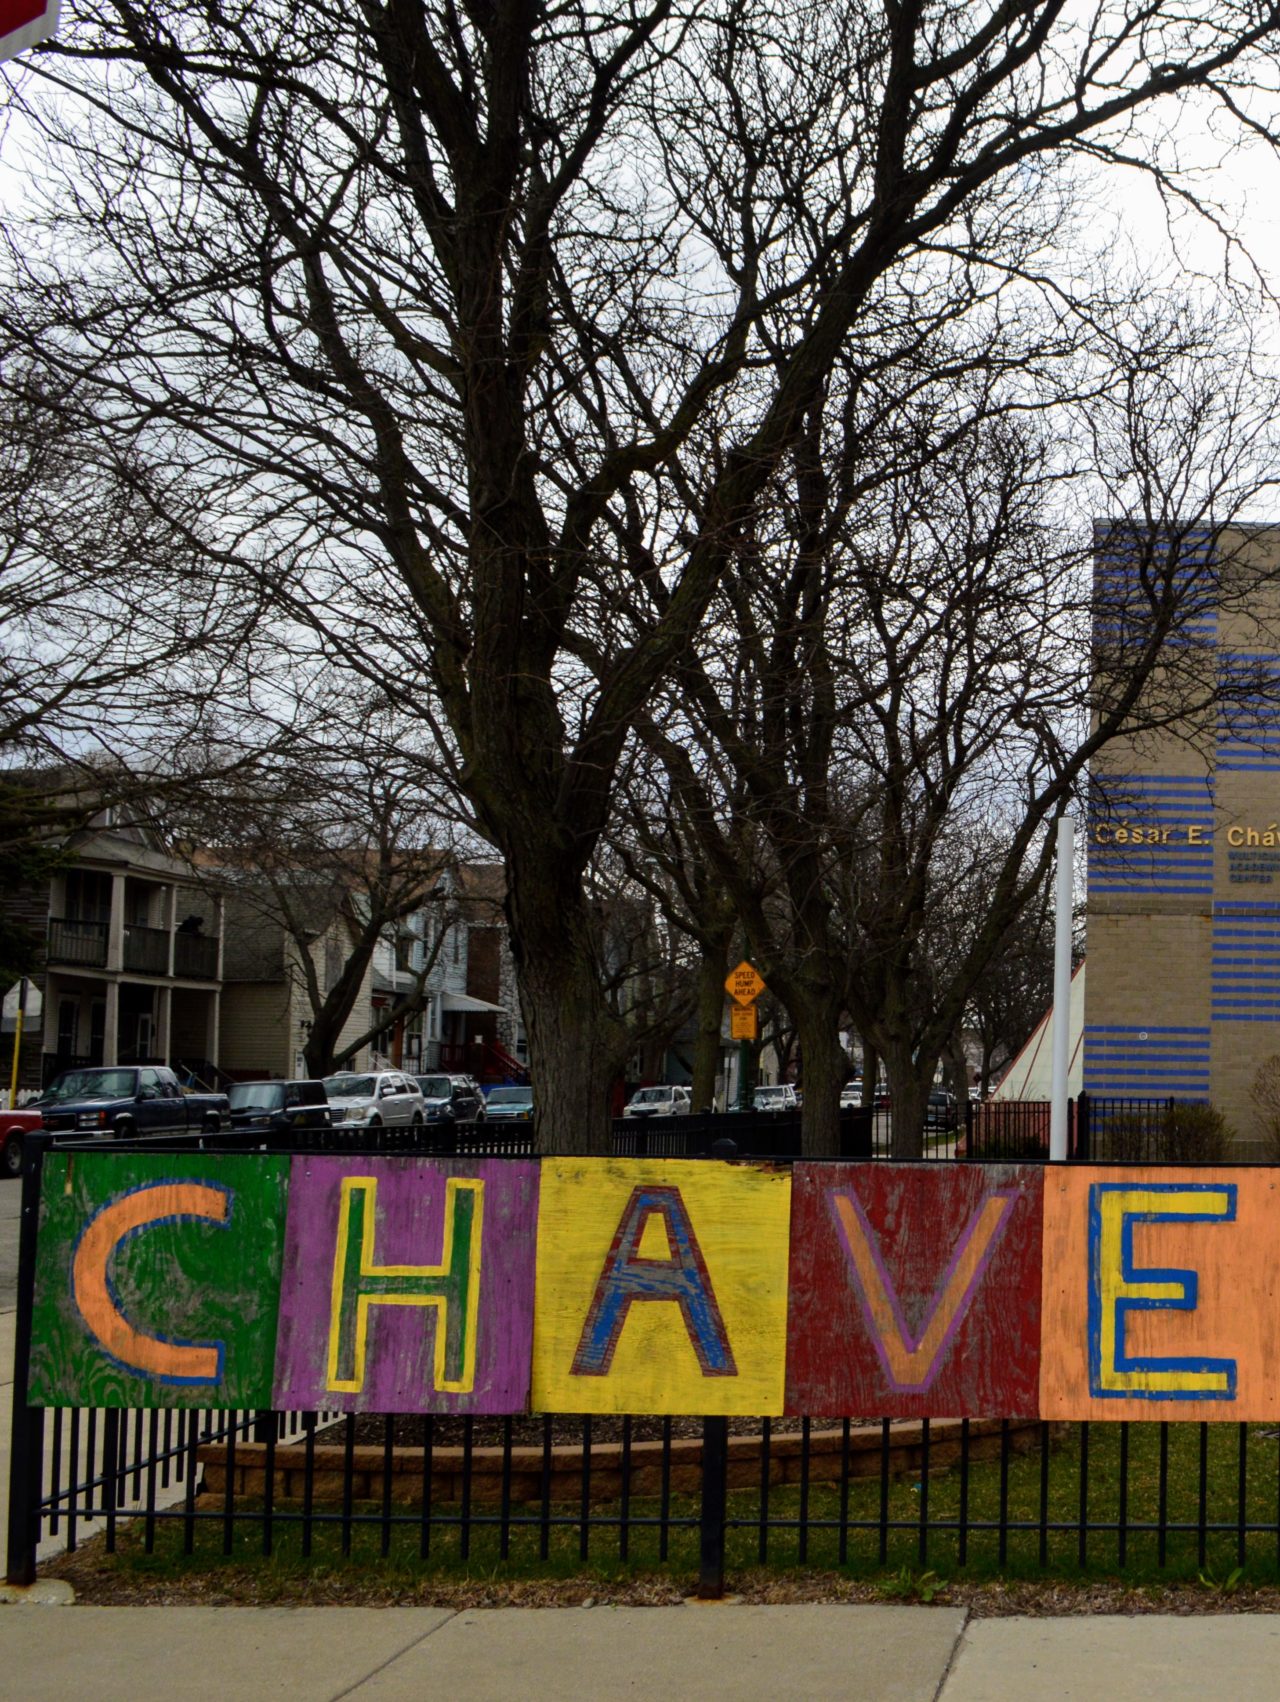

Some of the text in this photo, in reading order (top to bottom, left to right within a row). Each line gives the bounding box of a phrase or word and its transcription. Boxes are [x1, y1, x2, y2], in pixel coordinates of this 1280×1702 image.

[1095, 820, 1171, 844] César
[1188, 825, 1210, 845] E.
[734, 971, 755, 979] SPEED
